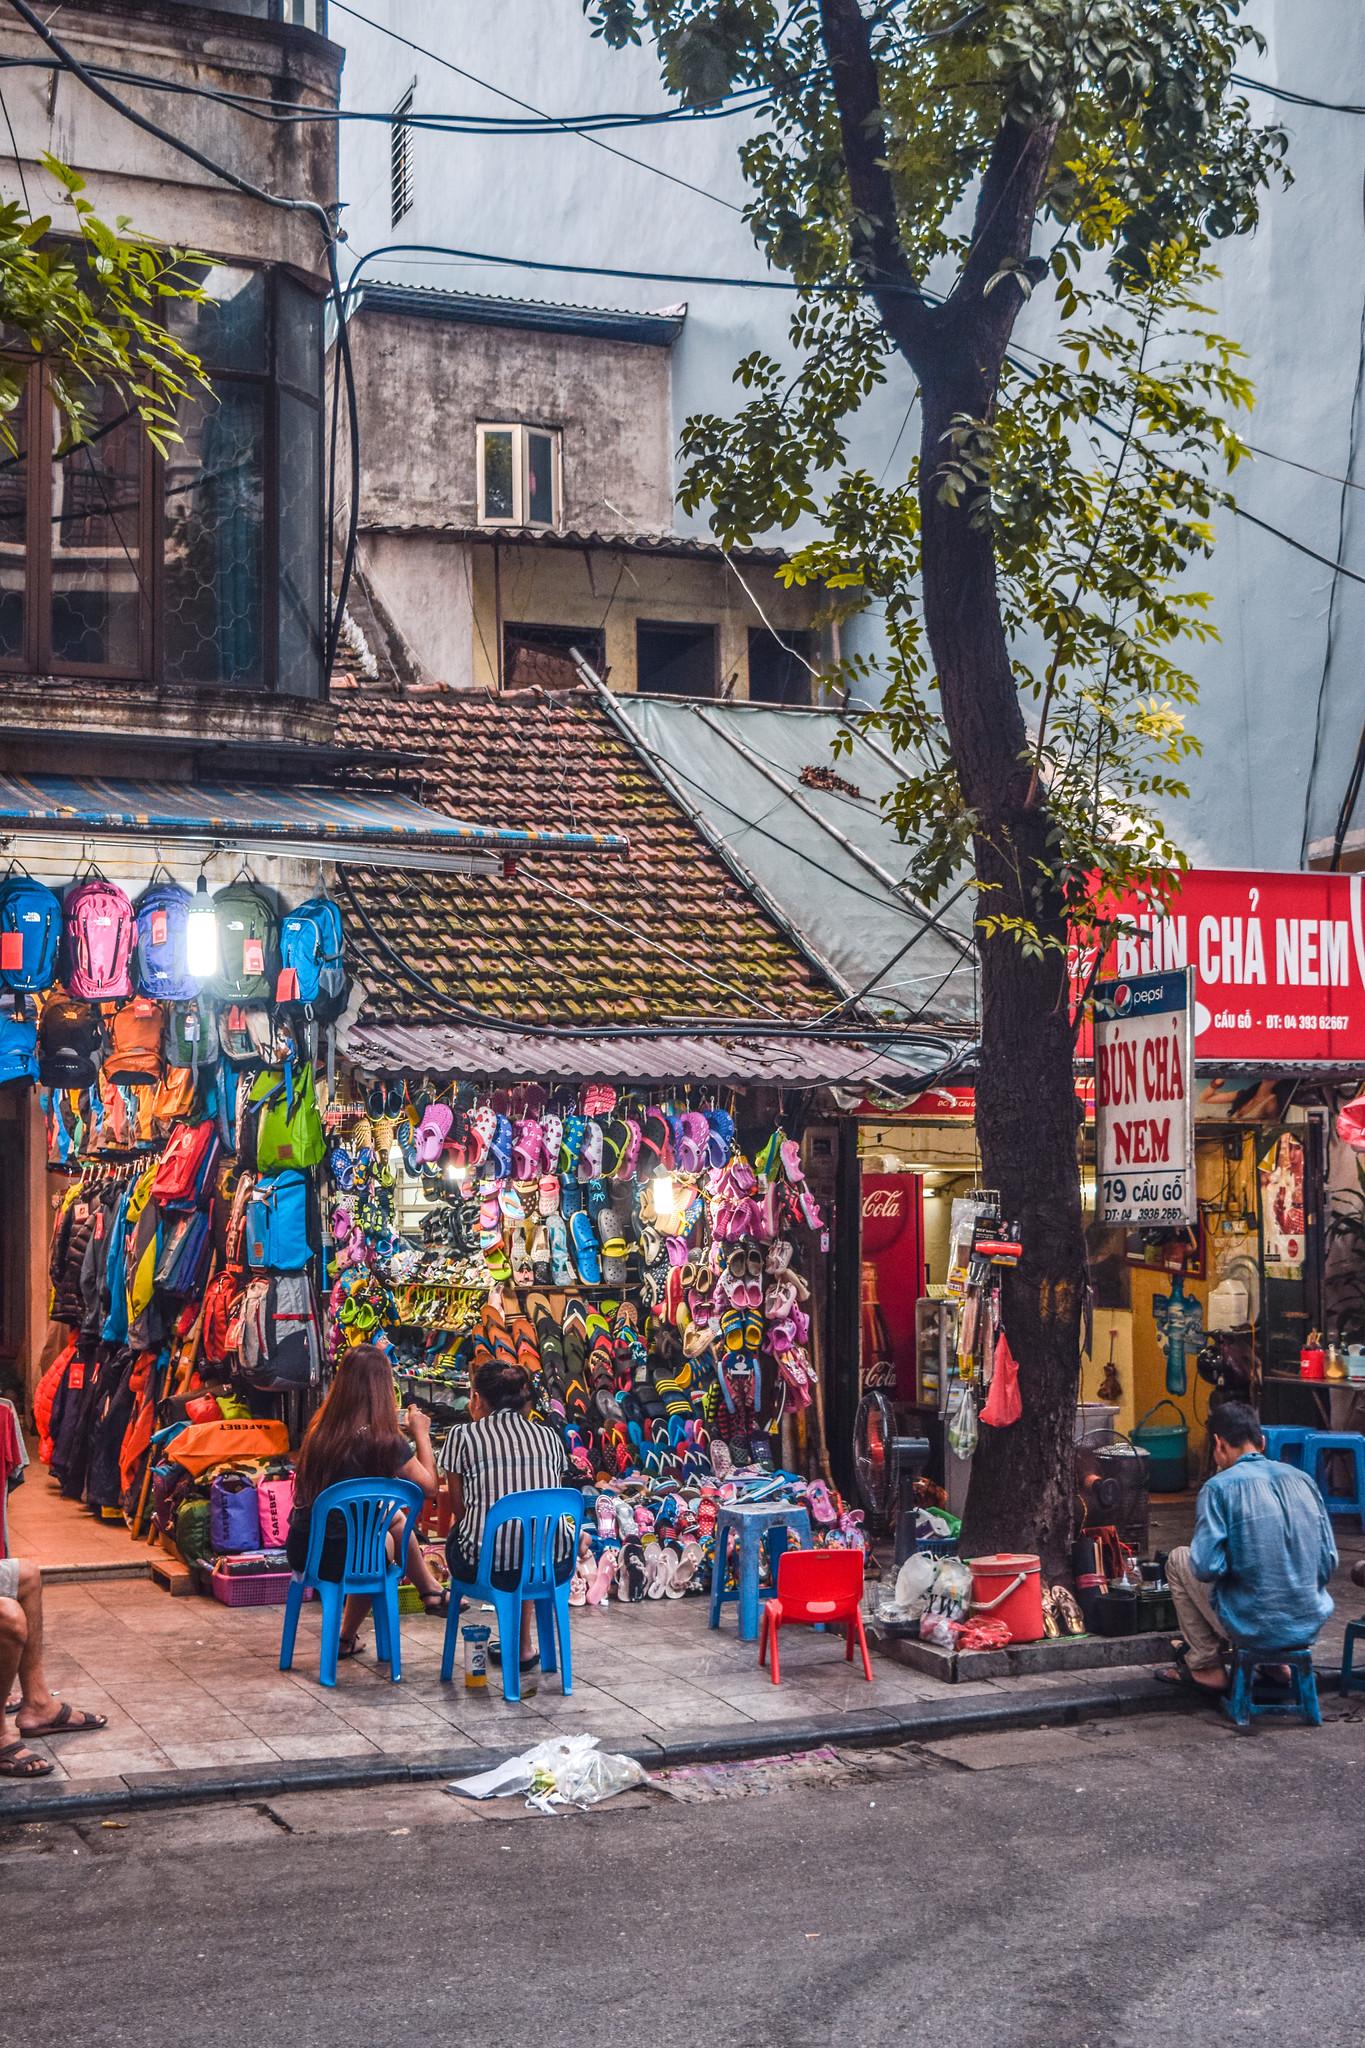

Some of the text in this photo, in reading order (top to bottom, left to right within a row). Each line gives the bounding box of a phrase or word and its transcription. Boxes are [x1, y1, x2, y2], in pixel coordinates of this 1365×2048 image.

[1199, 887, 1266, 985] CHẢ
[1276, 918, 1349, 987] NEM
[1134, 985, 1164, 1006] pepsi
[1284, 1015, 1297, 1029] 04
[1299, 1015, 1317, 1029] 393
[1319, 1015, 1349, 1030] 62667
[1098, 1016, 1184, 1107] BÚN CHẢ
[1113, 1117, 1171, 1165] NEM
[1103, 1175, 1183, 1203] 19 CẦU GỖ
[1121, 1209, 1132, 1219] 04
[220, 1423, 271, 1431] SAFEBET
[268, 1489, 280, 1536] SAFEBET
